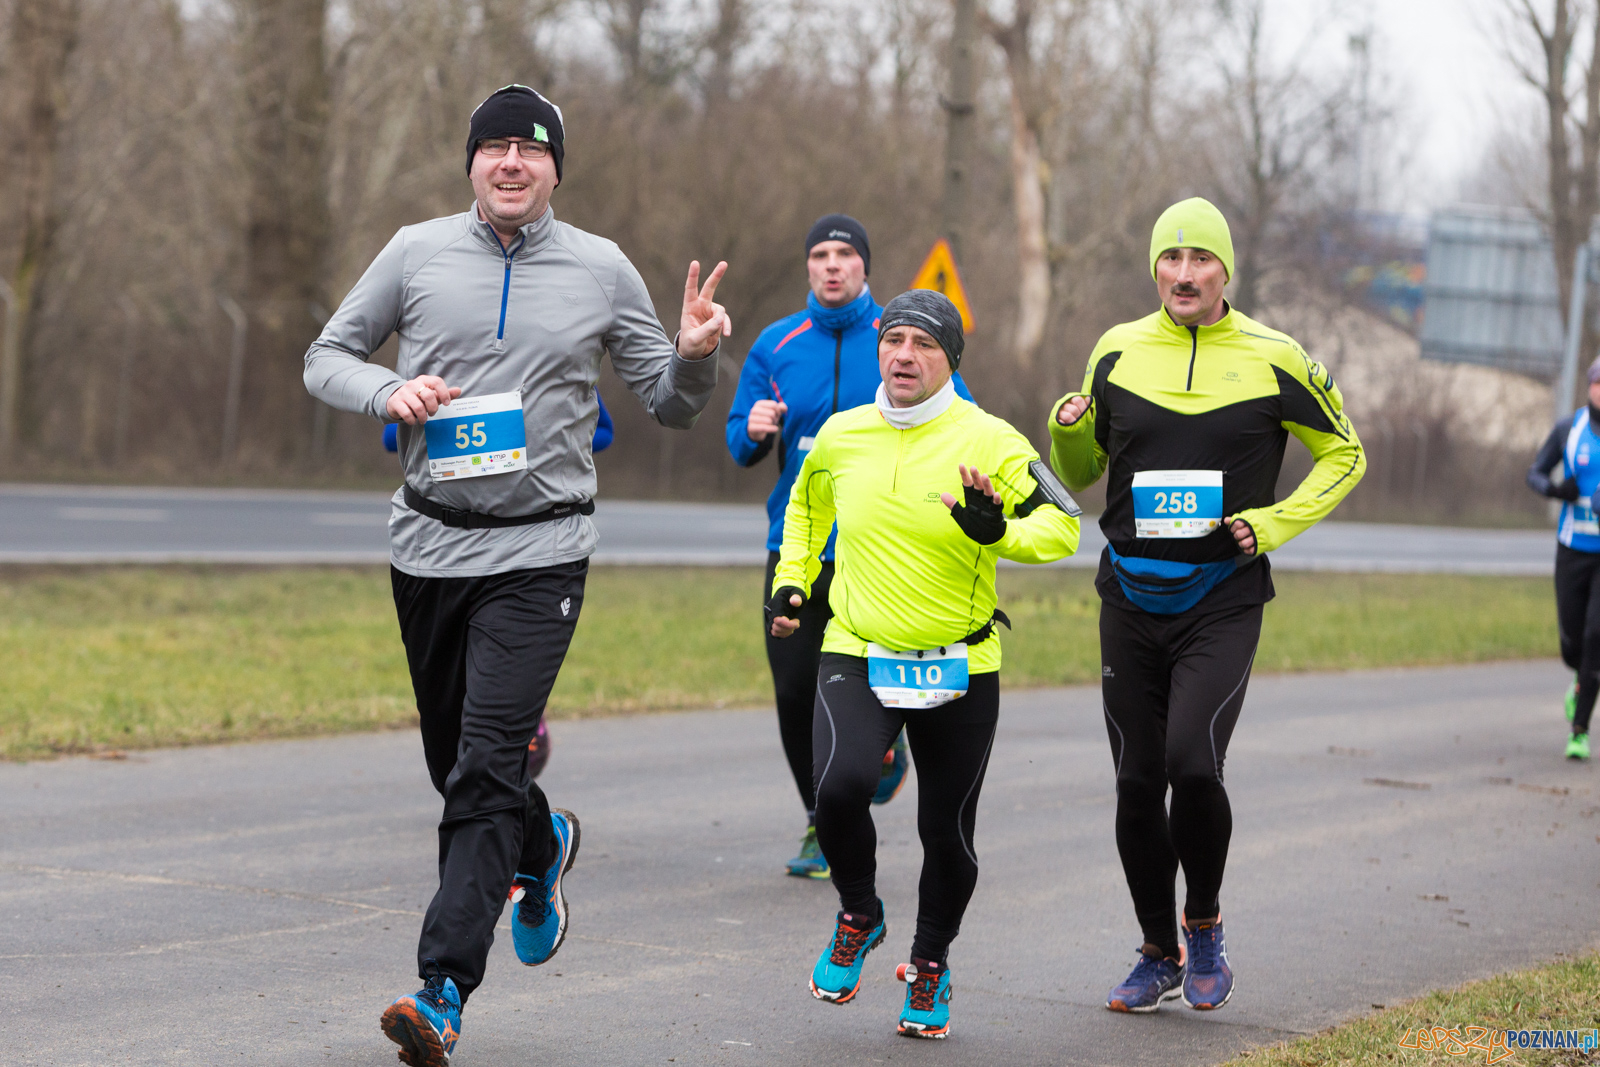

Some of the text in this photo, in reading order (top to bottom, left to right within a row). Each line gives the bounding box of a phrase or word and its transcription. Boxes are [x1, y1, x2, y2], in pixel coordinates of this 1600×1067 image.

[455, 422, 487, 449] 55
[1154, 491, 1198, 516] 258
[896, 665, 942, 685] 110
